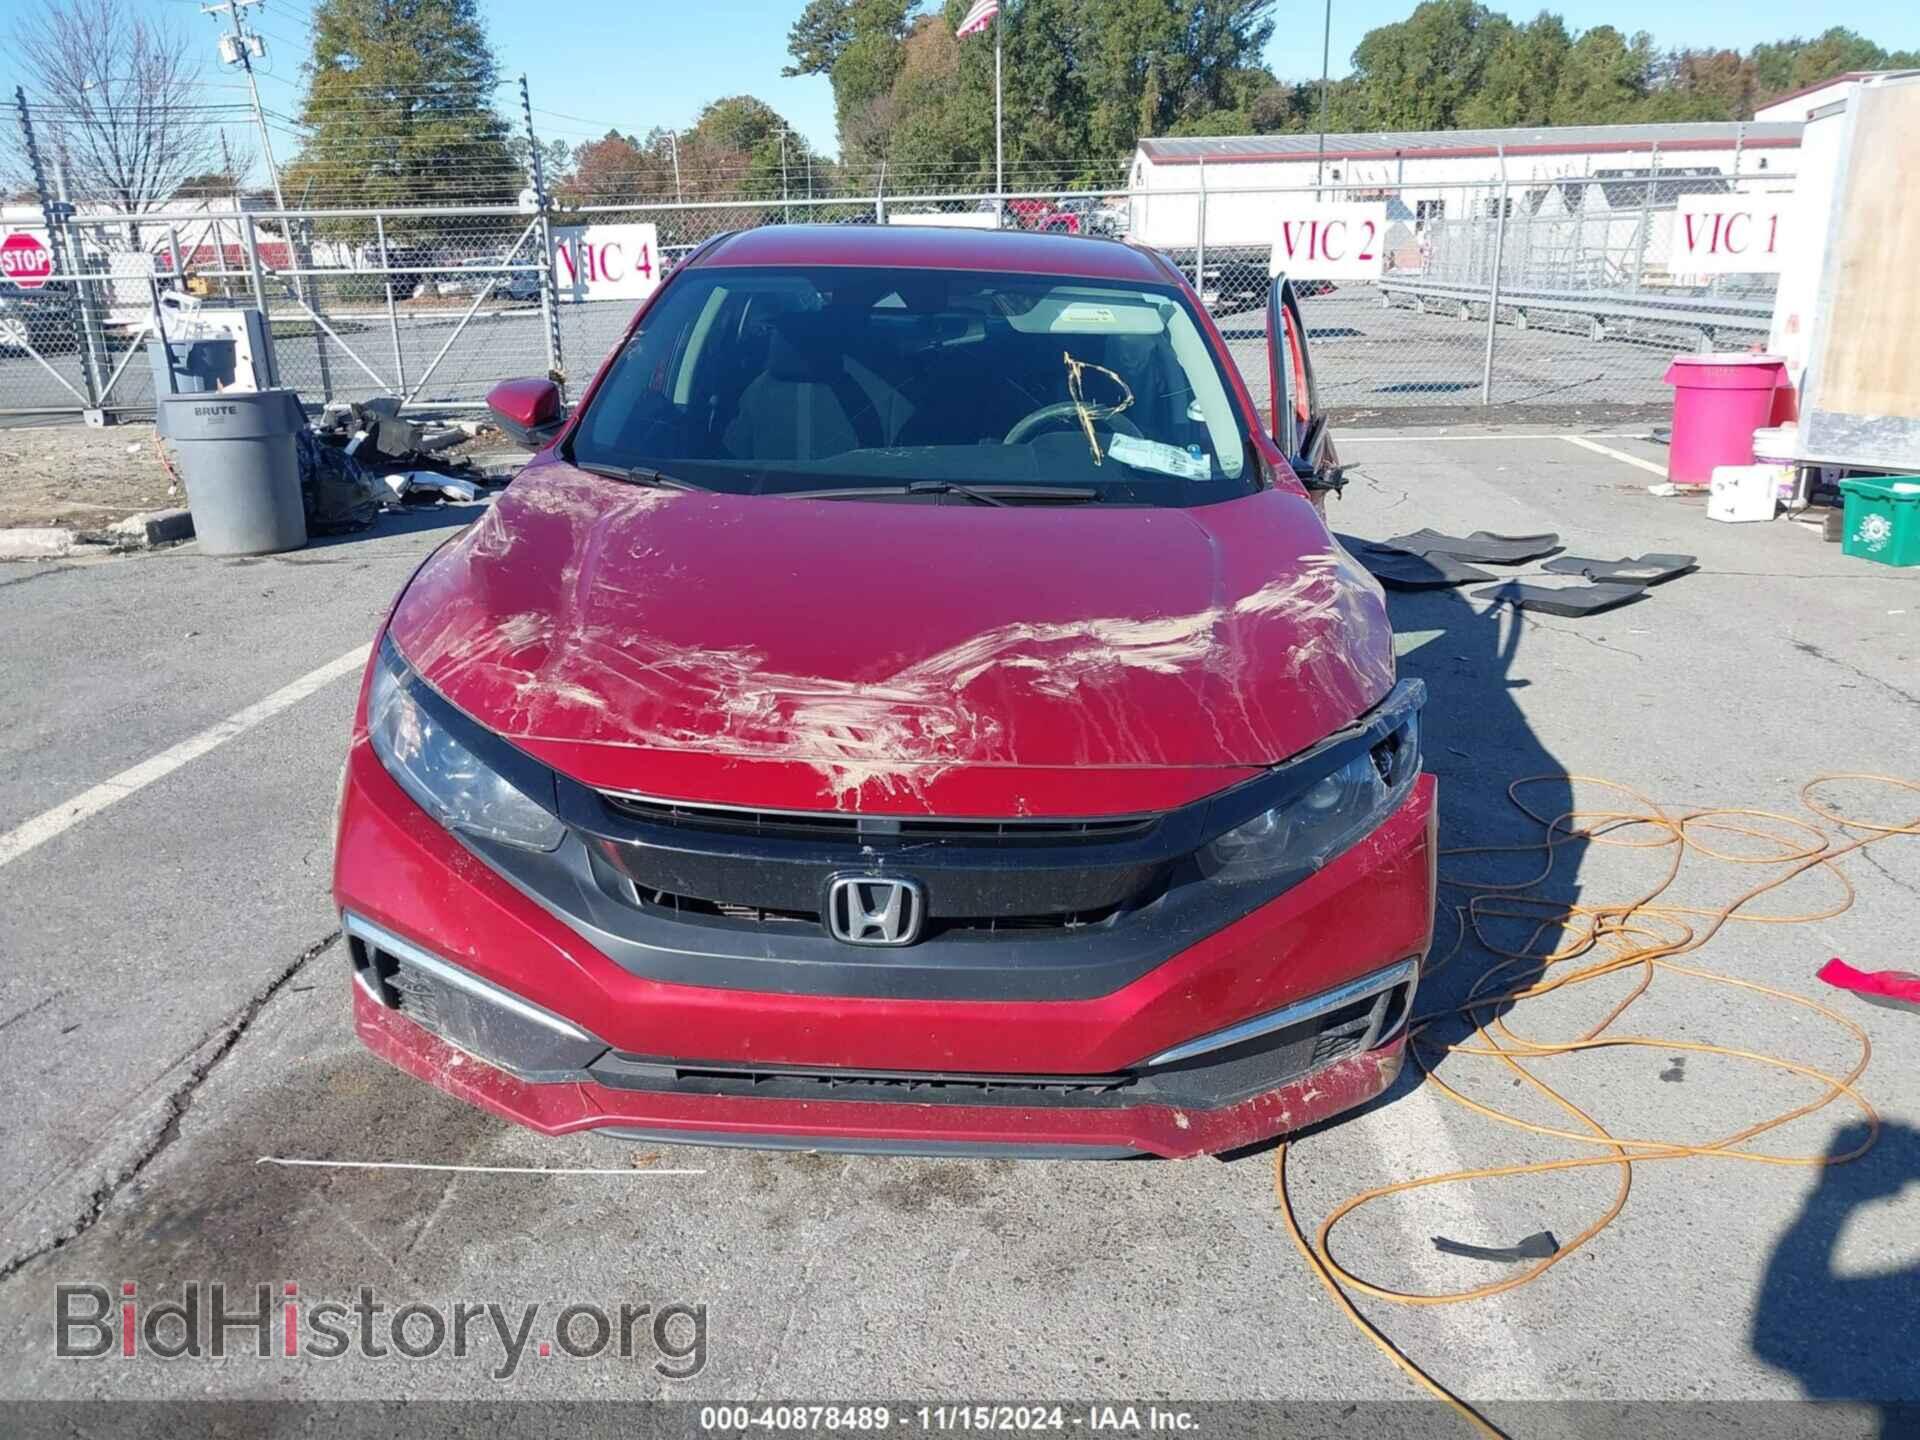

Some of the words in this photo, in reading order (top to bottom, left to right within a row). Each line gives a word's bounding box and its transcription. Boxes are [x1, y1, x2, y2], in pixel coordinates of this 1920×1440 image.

[1282, 219, 1346, 261] VIC
[1358, 220, 1376, 260] 2
[1682, 211, 1752, 254] VIC
[1765, 212, 1779, 253] 1
[2, 249, 47, 272] STOP
[557, 241, 625, 283] VIC
[636, 241, 652, 280] 4
[194, 405, 239, 417] BRUTE
